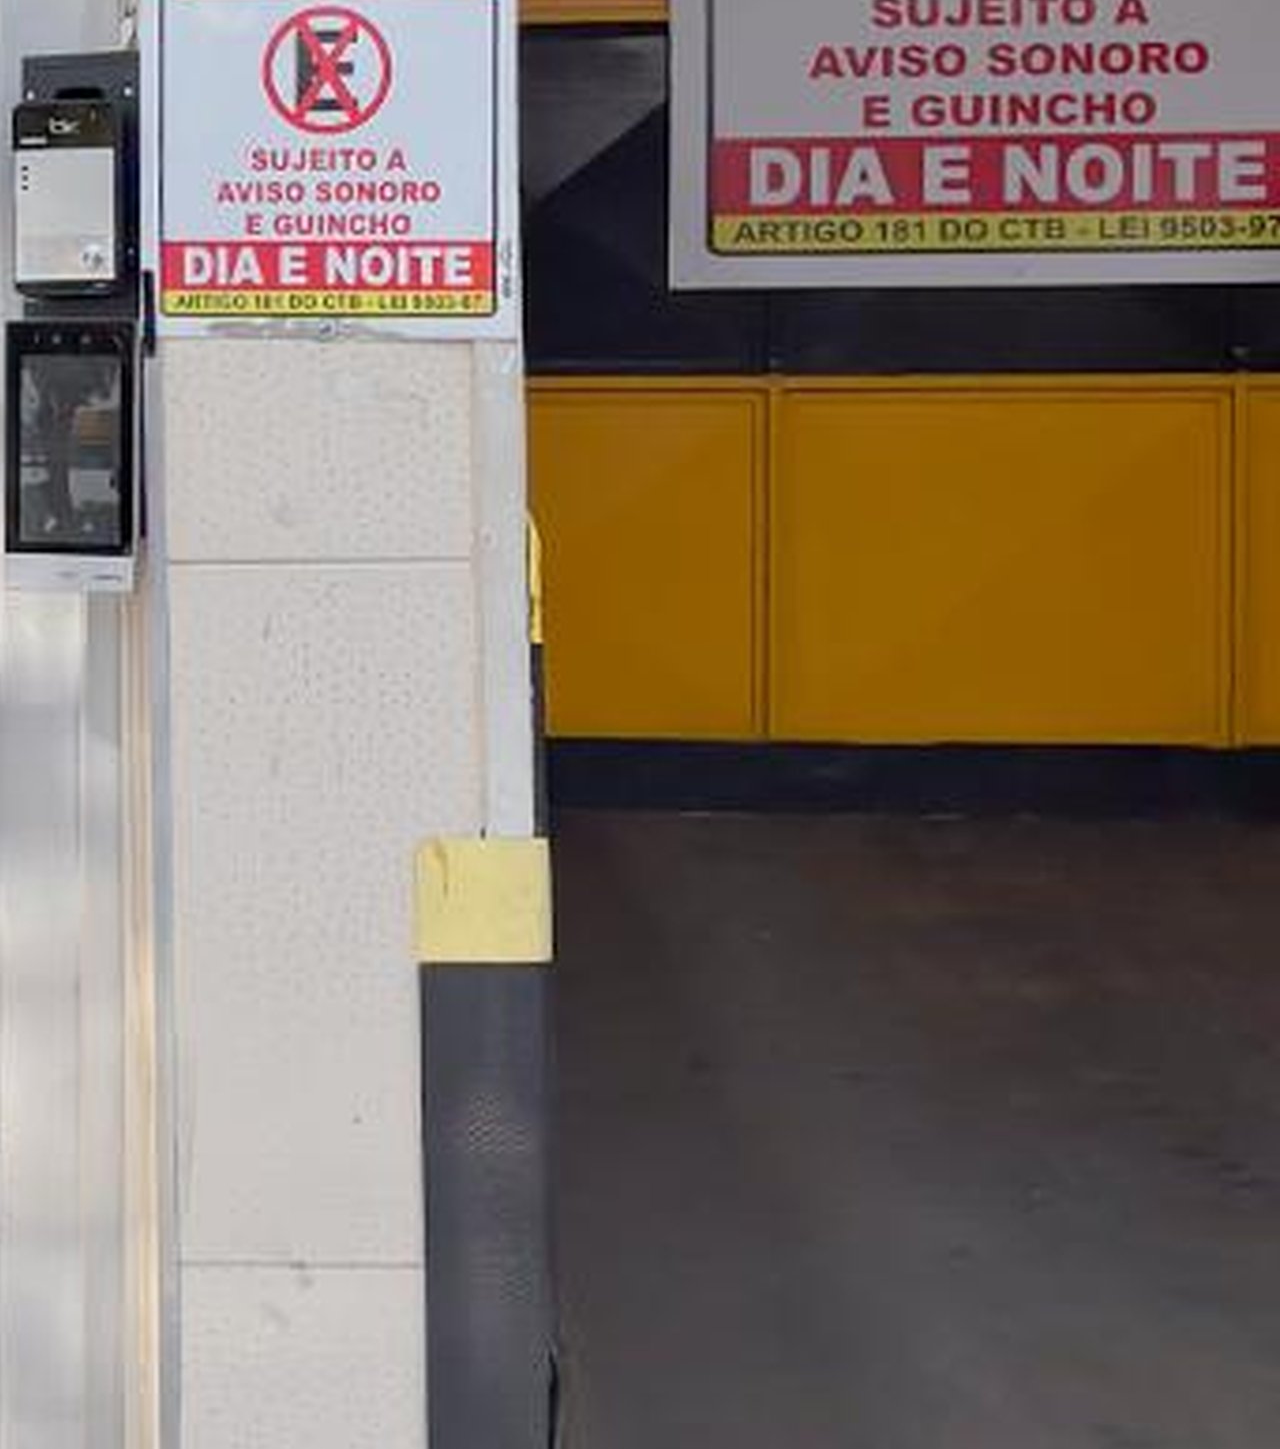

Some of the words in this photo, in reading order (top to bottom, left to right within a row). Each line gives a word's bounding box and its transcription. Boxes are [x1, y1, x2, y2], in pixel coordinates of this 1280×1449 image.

[809, 45, 967, 78] AVISO
[988, 42, 1210, 75] SONORO
[862, 96, 890, 128] E
[912, 92, 1158, 128] GUINCHO
[250, 149, 376, 172] SUJEITO
[386, 149, 407, 171] A
[749, 147, 894, 206] DIA
[923, 145, 971, 204] E
[1003, 142, 1267, 204] NOITE
[218, 182, 305, 203] AVISO
[316, 181, 440, 203] SONORO
[246, 215, 262, 235] E
[274, 214, 412, 236] GUINCHO
[734, 219, 863, 245] ARTIGO
[876, 219, 927, 242] 181
[940, 217, 988, 242] DO
[999, 217, 1065, 241] CTB
[1099, 215, 1149, 239] LEI
[183, 249, 261, 285] DIA
[279, 249, 307, 285] E
[326, 248, 472, 285] NOITE
